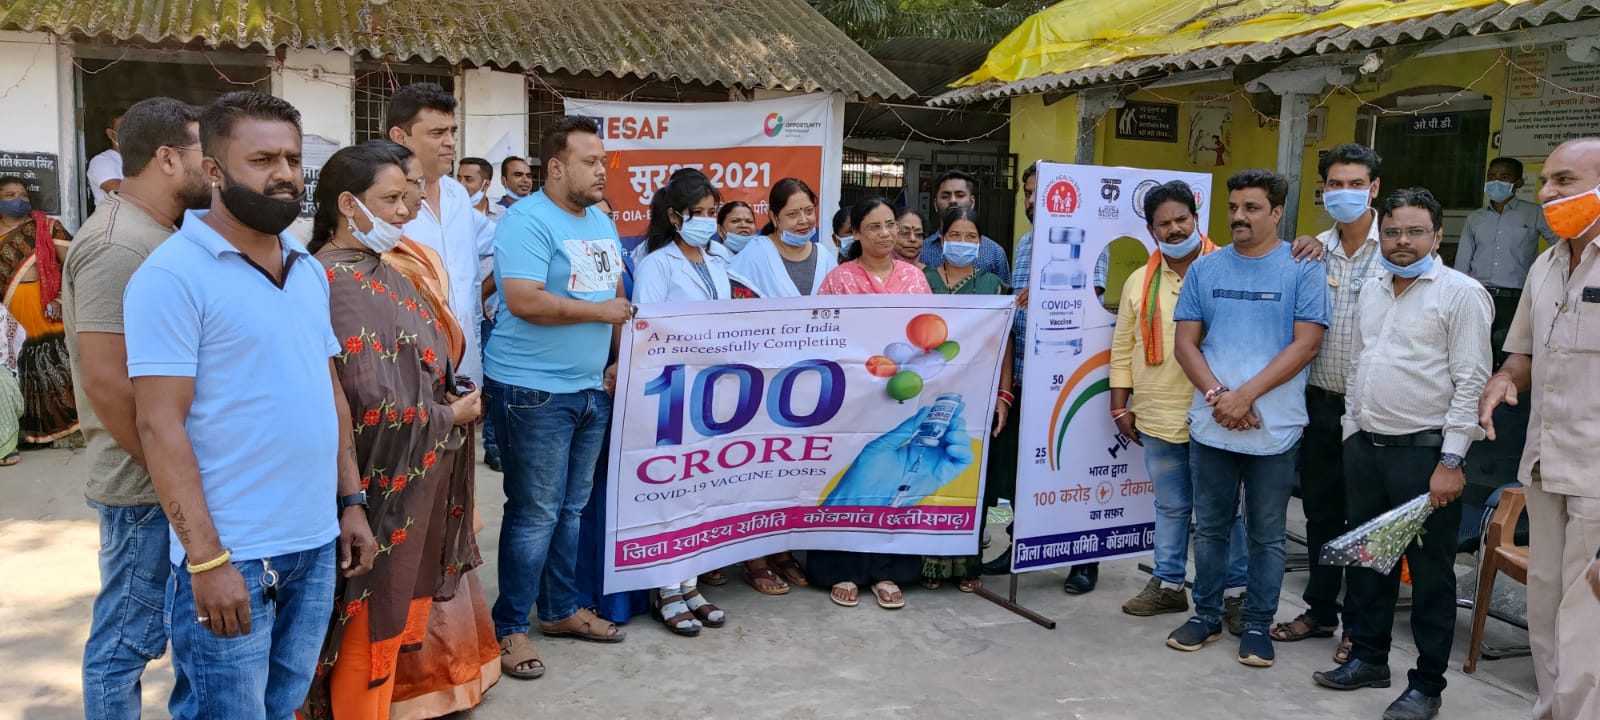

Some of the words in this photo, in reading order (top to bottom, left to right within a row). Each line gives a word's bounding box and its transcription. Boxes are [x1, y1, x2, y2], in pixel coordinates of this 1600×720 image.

[607, 116, 669, 139] ESAF
[710, 162, 771, 189] 2021
[1041, 300, 1082, 310] COVID-19
[647, 331, 660, 342] A
[665, 329, 712, 344] proud
[716, 326, 776, 340] moment
[781, 324, 801, 335] for
[805, 322, 841, 333] India
[1049, 318, 1072, 326] Vaccine
[647, 345, 666, 356] on
[671, 340, 760, 355] successfully
[764, 336, 847, 350] Completing
[1052, 374, 1064, 385] 50
[644, 358, 847, 447] 100
[636, 436, 833, 485] CRORE
[1035, 447, 1047, 458] 25
[1089, 464, 1109, 477] भारत
[1111, 463, 1128, 478] द्वारा
[634, 481, 708, 503] COVID-19
[710, 469, 773, 489] VACCINE
[778, 467, 827, 478] DOSES
[1033, 491, 1056, 506] 100
[1060, 484, 1091, 505] करोड़
[1089, 510, 1102, 521] का
[623, 541, 668, 562] जिला
[672, 524, 733, 551] स्वास्थ्य
[736, 512, 787, 534] समिति
[1016, 543, 1041, 564] जिला
[1042, 540, 1071, 559] स्वास्थ्य
[1072, 534, 1099, 555] समिति
